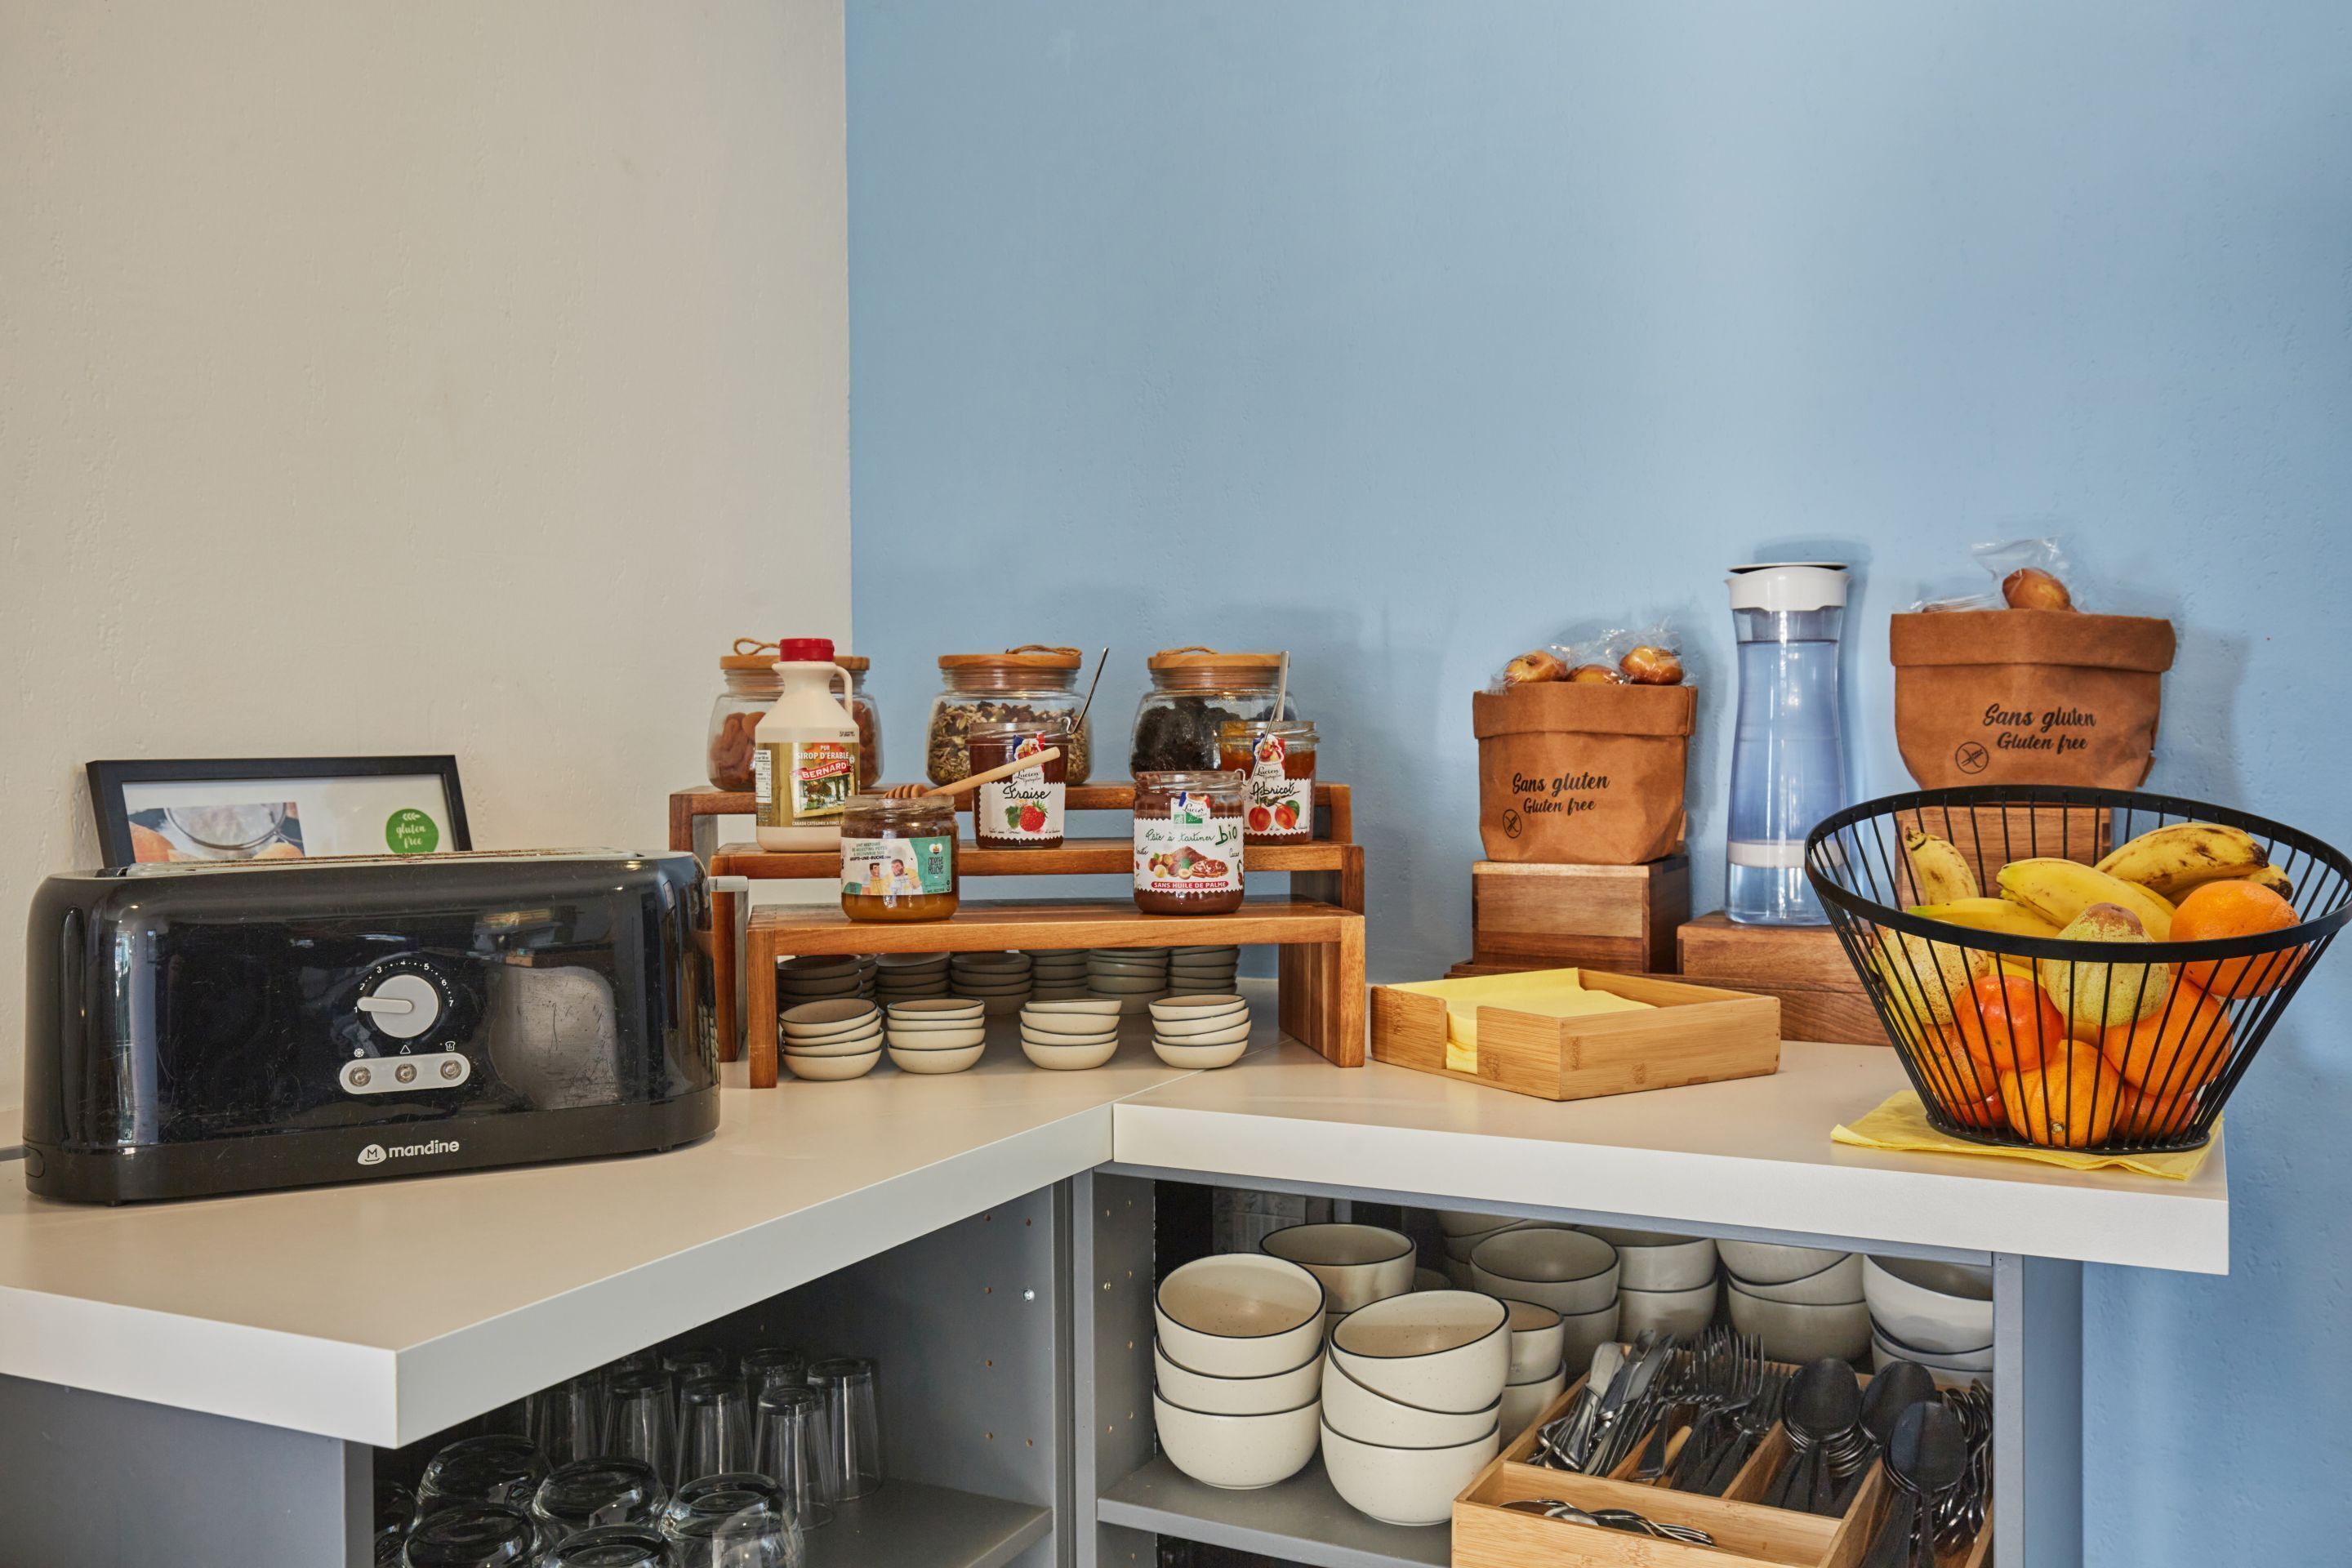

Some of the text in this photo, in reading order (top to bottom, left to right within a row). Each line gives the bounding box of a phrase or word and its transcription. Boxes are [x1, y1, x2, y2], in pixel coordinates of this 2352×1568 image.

[1983, 703, 2096, 733] Sans gluten
[1996, 732, 2088, 755] Gluten free
[801, 762, 847, 779] BERNARD
[1254, 766, 1280, 777] Lucien
[1003, 781, 1052, 800] Fraise
[1250, 782, 1296, 798] Abricot
[1512, 772, 1610, 798] Sans gluten
[1523, 797, 1597, 816] Gluten free
[395, 822, 426, 839] gluten
[1145, 824, 1238, 846] Pâte à tartiner bio
[403, 836, 423, 849] free
[389, 1139, 460, 1158] mandine
